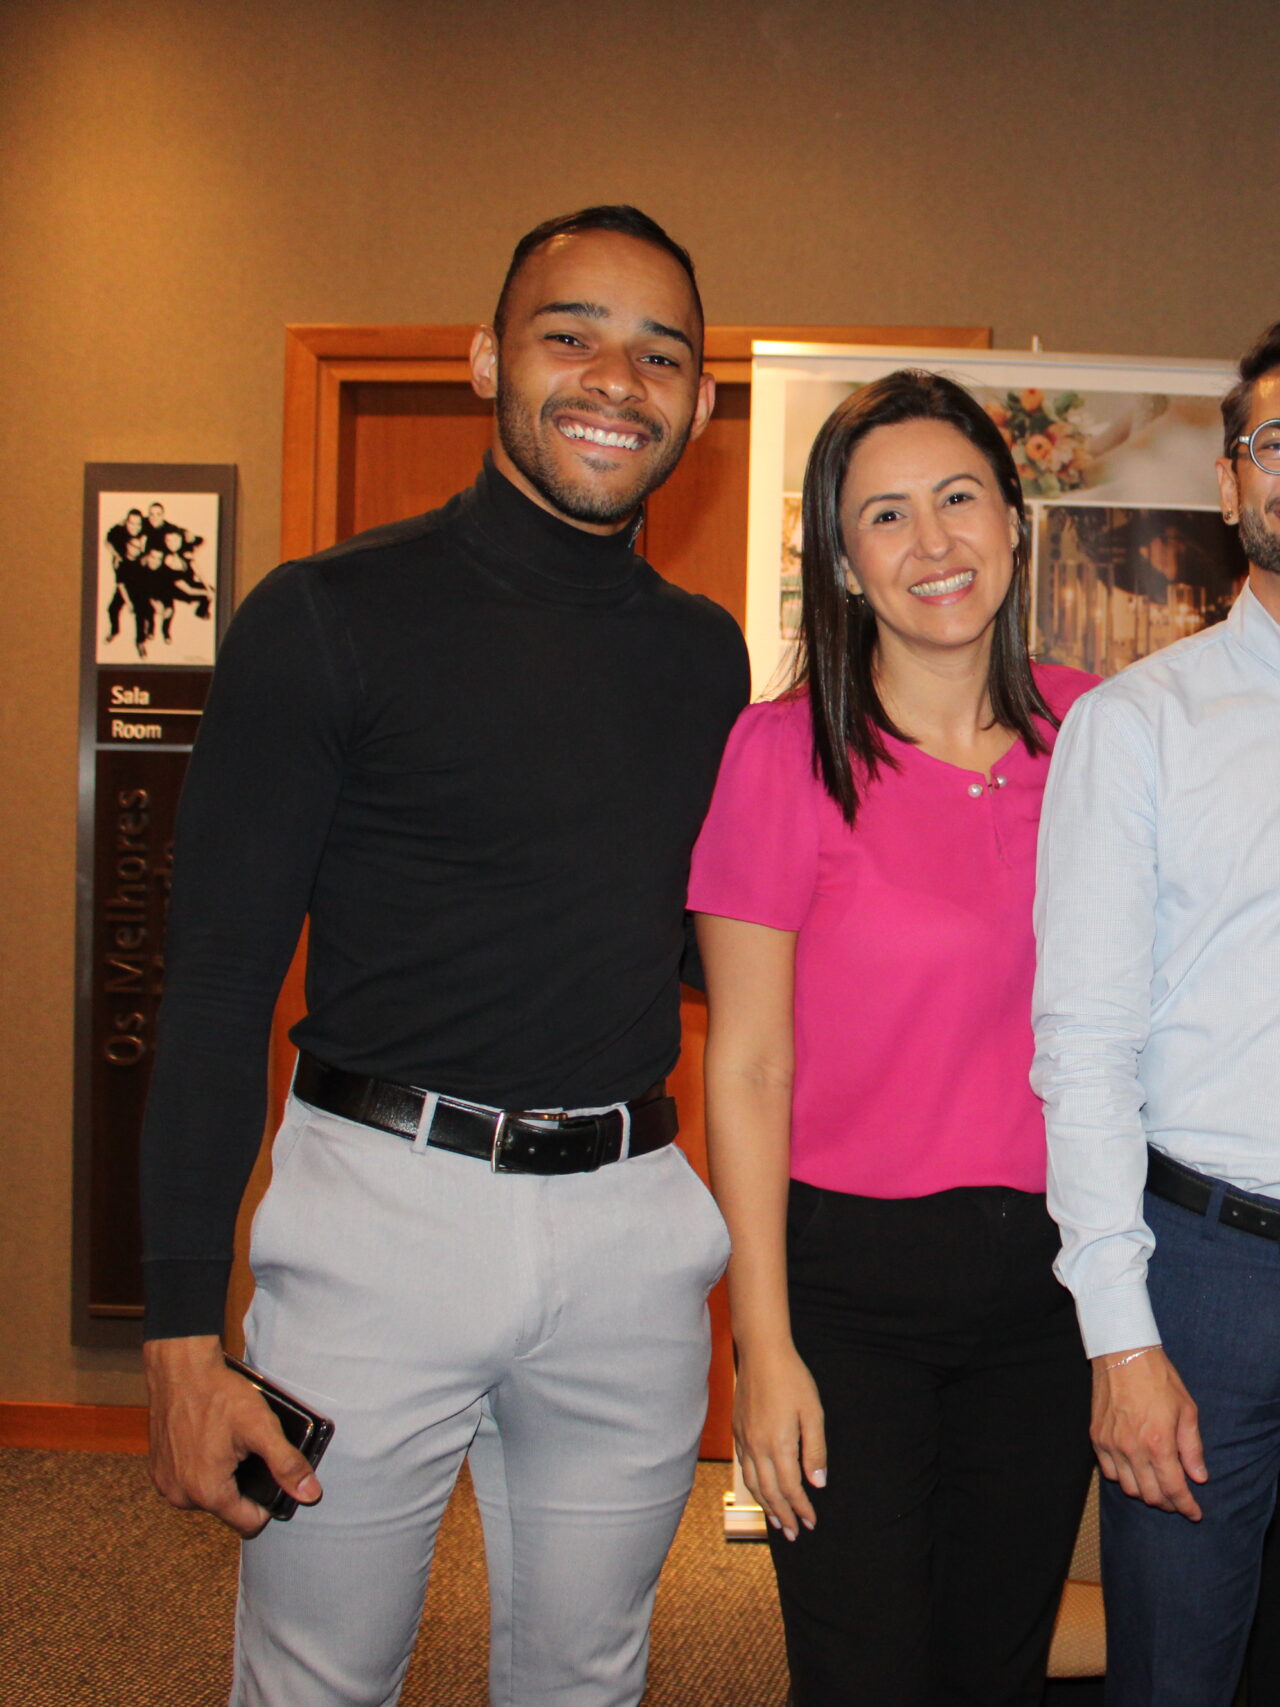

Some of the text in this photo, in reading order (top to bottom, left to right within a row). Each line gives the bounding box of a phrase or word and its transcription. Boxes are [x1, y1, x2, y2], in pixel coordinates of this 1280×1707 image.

[111, 685, 150, 705] Sala
[112, 719, 162, 739] Room
[103, 788, 150, 1067] Os Melhores
